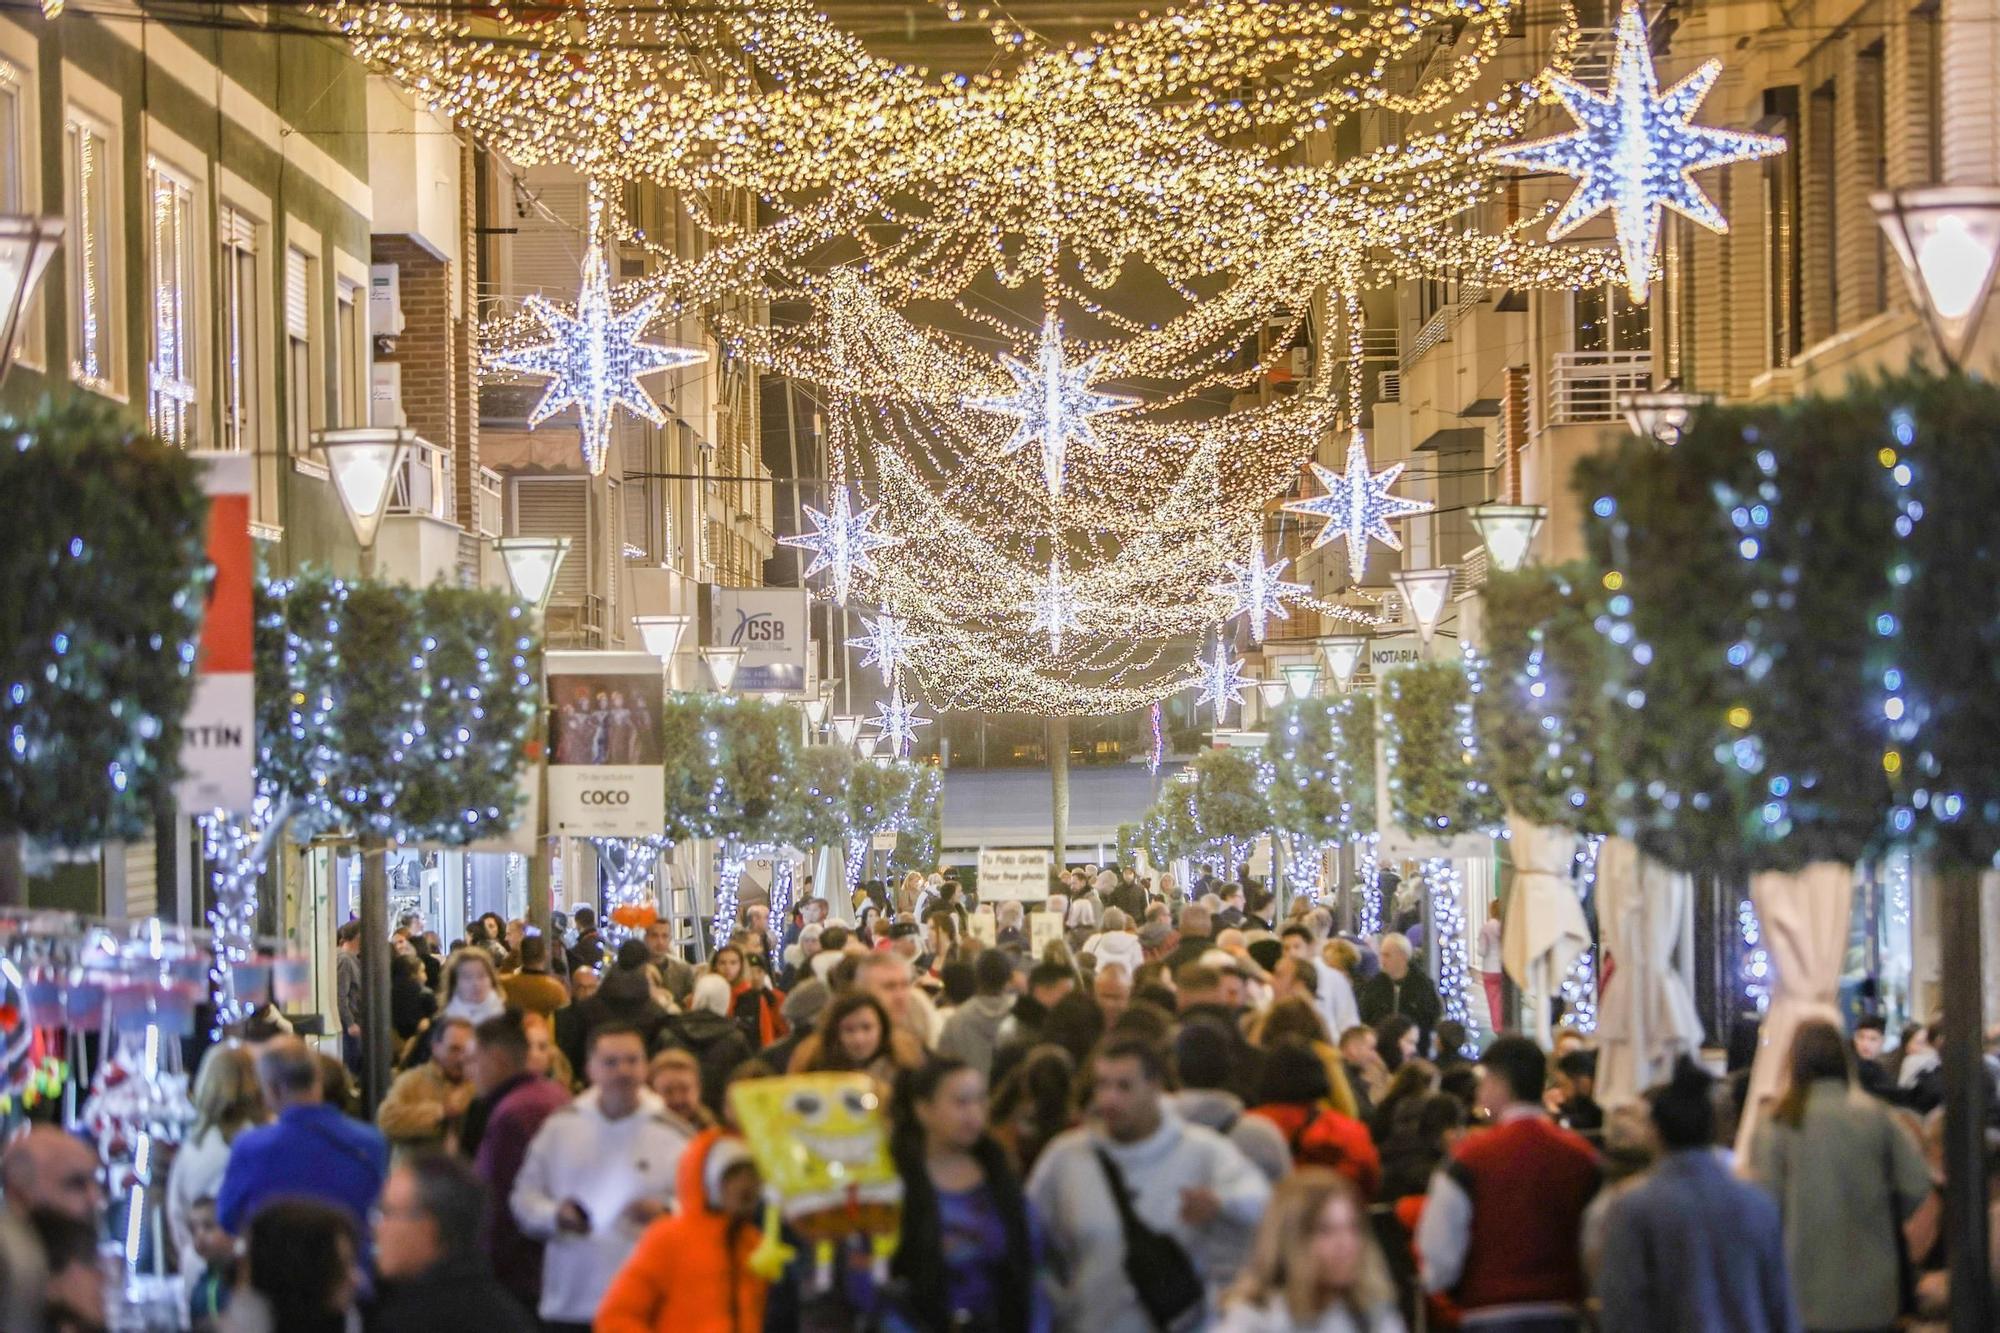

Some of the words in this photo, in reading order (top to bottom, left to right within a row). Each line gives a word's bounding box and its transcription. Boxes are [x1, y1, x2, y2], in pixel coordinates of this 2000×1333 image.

[748, 620, 785, 641] CSB
[1372, 649, 1419, 664] NOTARIA
[580, 790, 629, 804] COCO
[1021, 871, 1045, 883] photo
